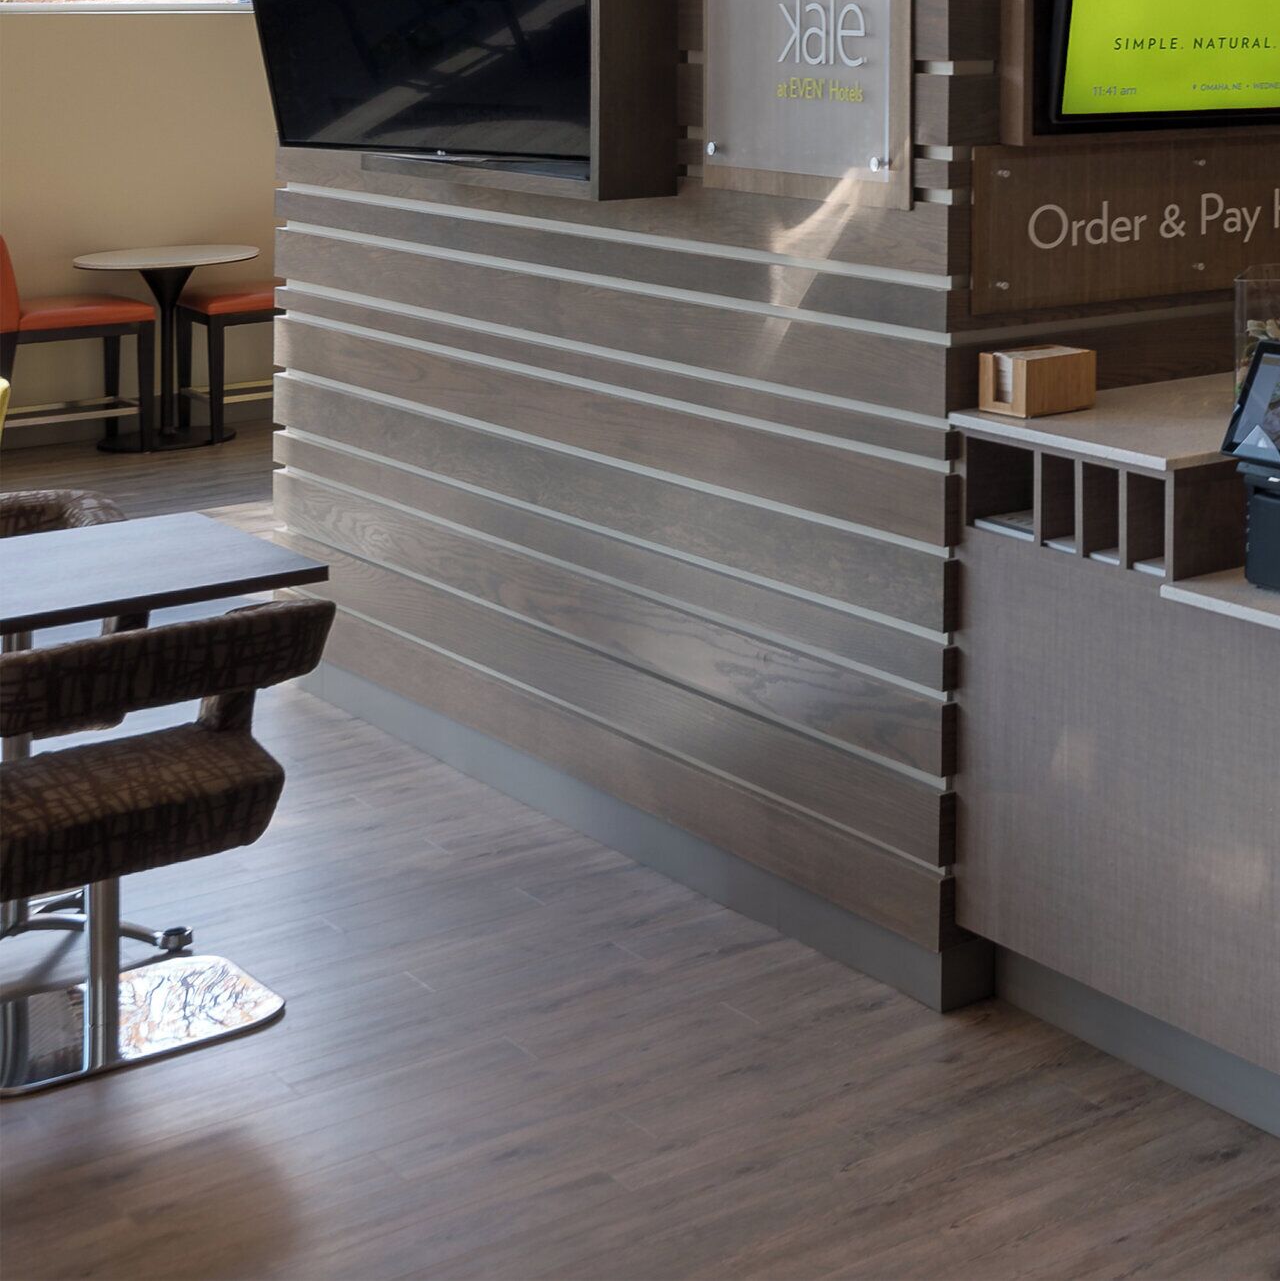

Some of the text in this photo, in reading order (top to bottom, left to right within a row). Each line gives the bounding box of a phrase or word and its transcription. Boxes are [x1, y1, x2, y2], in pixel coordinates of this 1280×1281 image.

[1113, 37, 1185, 51] SIMPLE.
[1193, 36, 1277, 50] NATURAL.
[776, 81, 789, 98] at
[828, 79, 864, 103] Hotels
[1092, 85, 1137, 96] 11:41 am
[1027, 200, 1148, 249] Order
[1158, 203, 1187, 239] &
[1200, 191, 1262, 243] Pay
